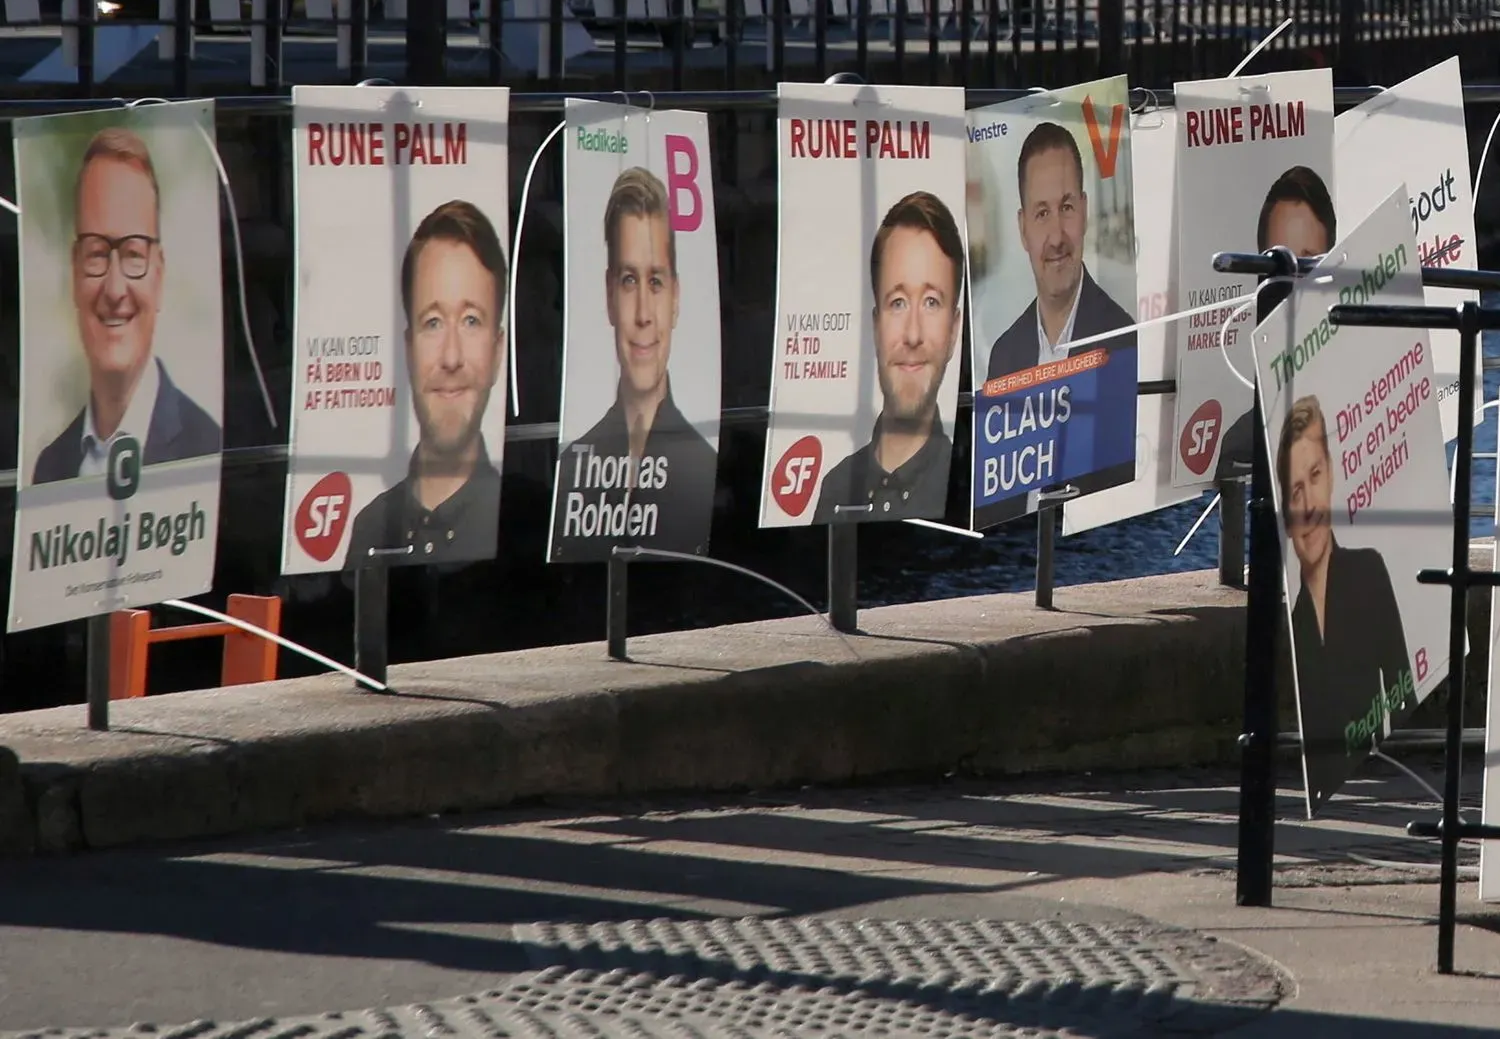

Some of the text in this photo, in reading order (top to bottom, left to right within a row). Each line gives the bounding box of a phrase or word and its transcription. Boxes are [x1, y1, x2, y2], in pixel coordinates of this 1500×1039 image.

[308, 123, 467, 165] RUNE PALM
[577, 126, 628, 154] Radikale
[790, 119, 930, 159] RUNE PALM
[967, 121, 1008, 144] Venstre
[1081, 94, 1124, 179] V
[1187, 101, 1305, 147] RUNE PALM
[665, 134, 703, 232] B
[1188, 290, 1198, 307] VI
[1200, 287, 1217, 304] KAN
[787, 313, 851, 331] VI KAN GODT
[306, 336, 380, 356] VI KAN GODT
[785, 332, 820, 355] FÅ TID
[307, 357, 381, 383] FÅ BØRN UD
[784, 360, 848, 379] TIL FAMILIE
[304, 387, 395, 409] AF FATTIGDOM
[1336, 342, 1424, 444] Din stemme
[984, 385, 1071, 444] CLAUS
[1341, 376, 1430, 480] for en bedre
[1188, 418, 1215, 456] SF
[572, 444, 668, 489] Thomas
[779, 457, 816, 496] SF
[983, 440, 1054, 497] BUCH
[1346, 431, 1409, 525] psykiatri
[304, 495, 344, 538] SF
[563, 492, 658, 537] Rohden
[29, 501, 205, 571] Nikolaj Bøgh
[1415, 647, 1428, 682] B
